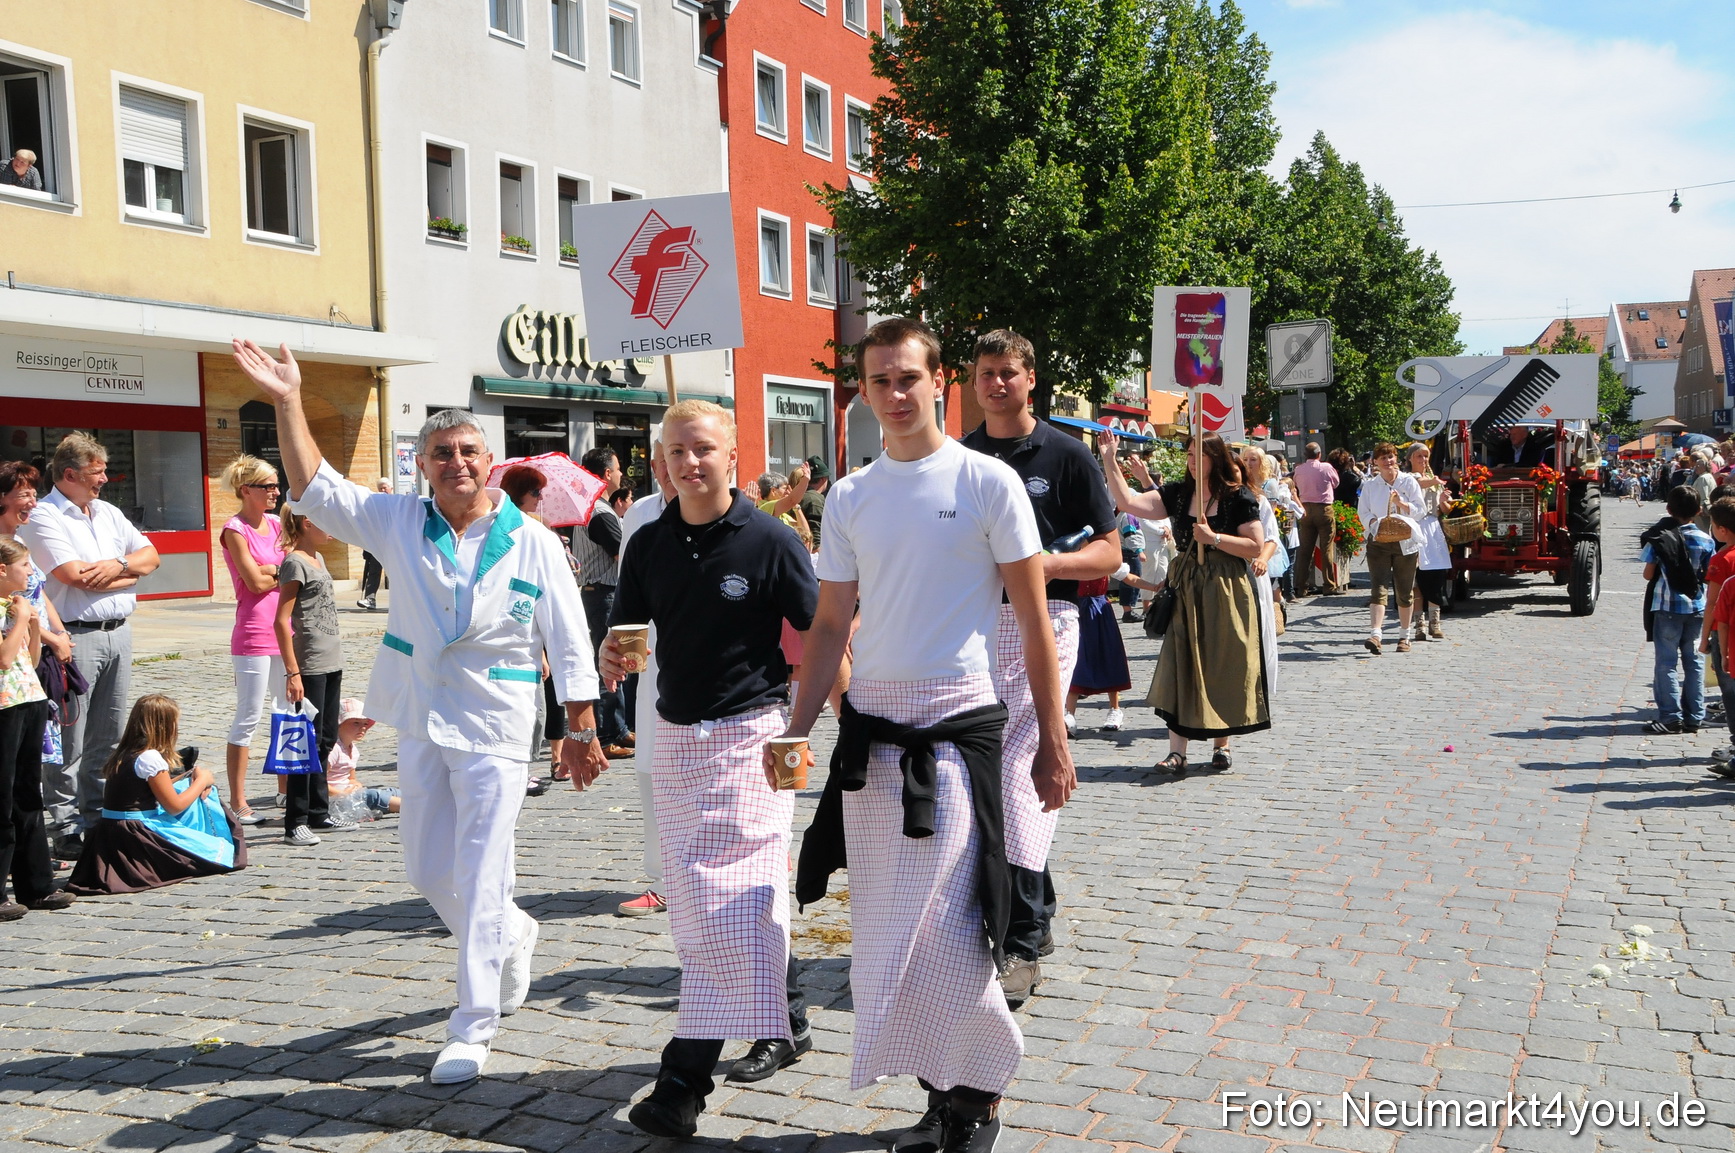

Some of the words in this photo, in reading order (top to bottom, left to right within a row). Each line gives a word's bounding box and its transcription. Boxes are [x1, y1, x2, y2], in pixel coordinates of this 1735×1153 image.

[621, 333, 713, 353] FLEISCHER
[16, 351, 82, 369] Reissinger
[86, 356, 118, 371] Optik
[87, 377, 143, 390] CENTRUM
[402, 403, 410, 414] 31
[217, 418, 228, 429] 30
